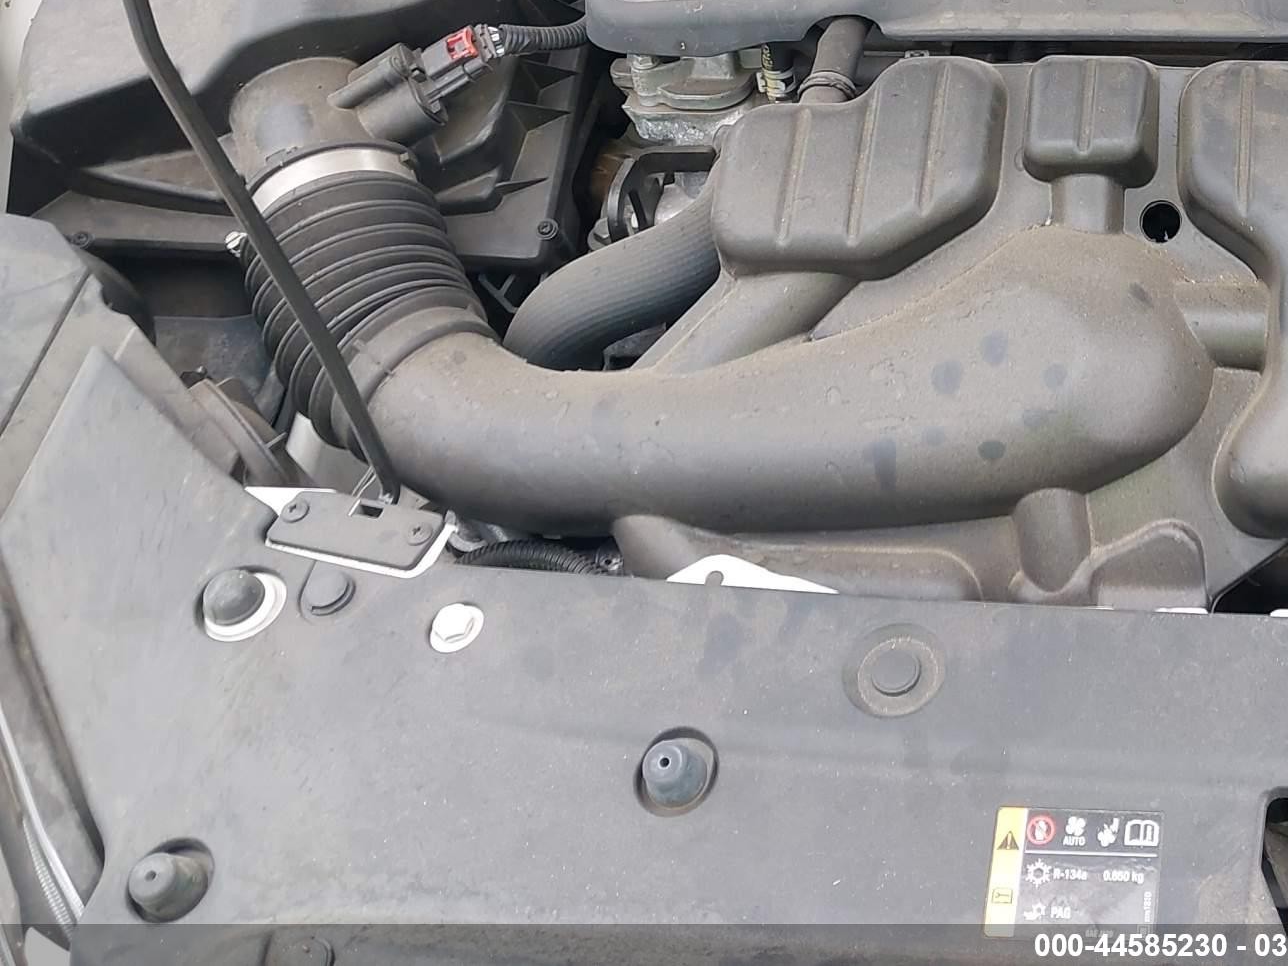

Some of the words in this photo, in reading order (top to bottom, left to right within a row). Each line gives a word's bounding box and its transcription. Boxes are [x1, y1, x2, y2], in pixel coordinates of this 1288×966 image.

[1063, 835, 1086, 846] AUTO
[1052, 867, 1088, 881] R-134a
[1131, 870, 1145, 885] kg
[1050, 905, 1071, 919] PAG
